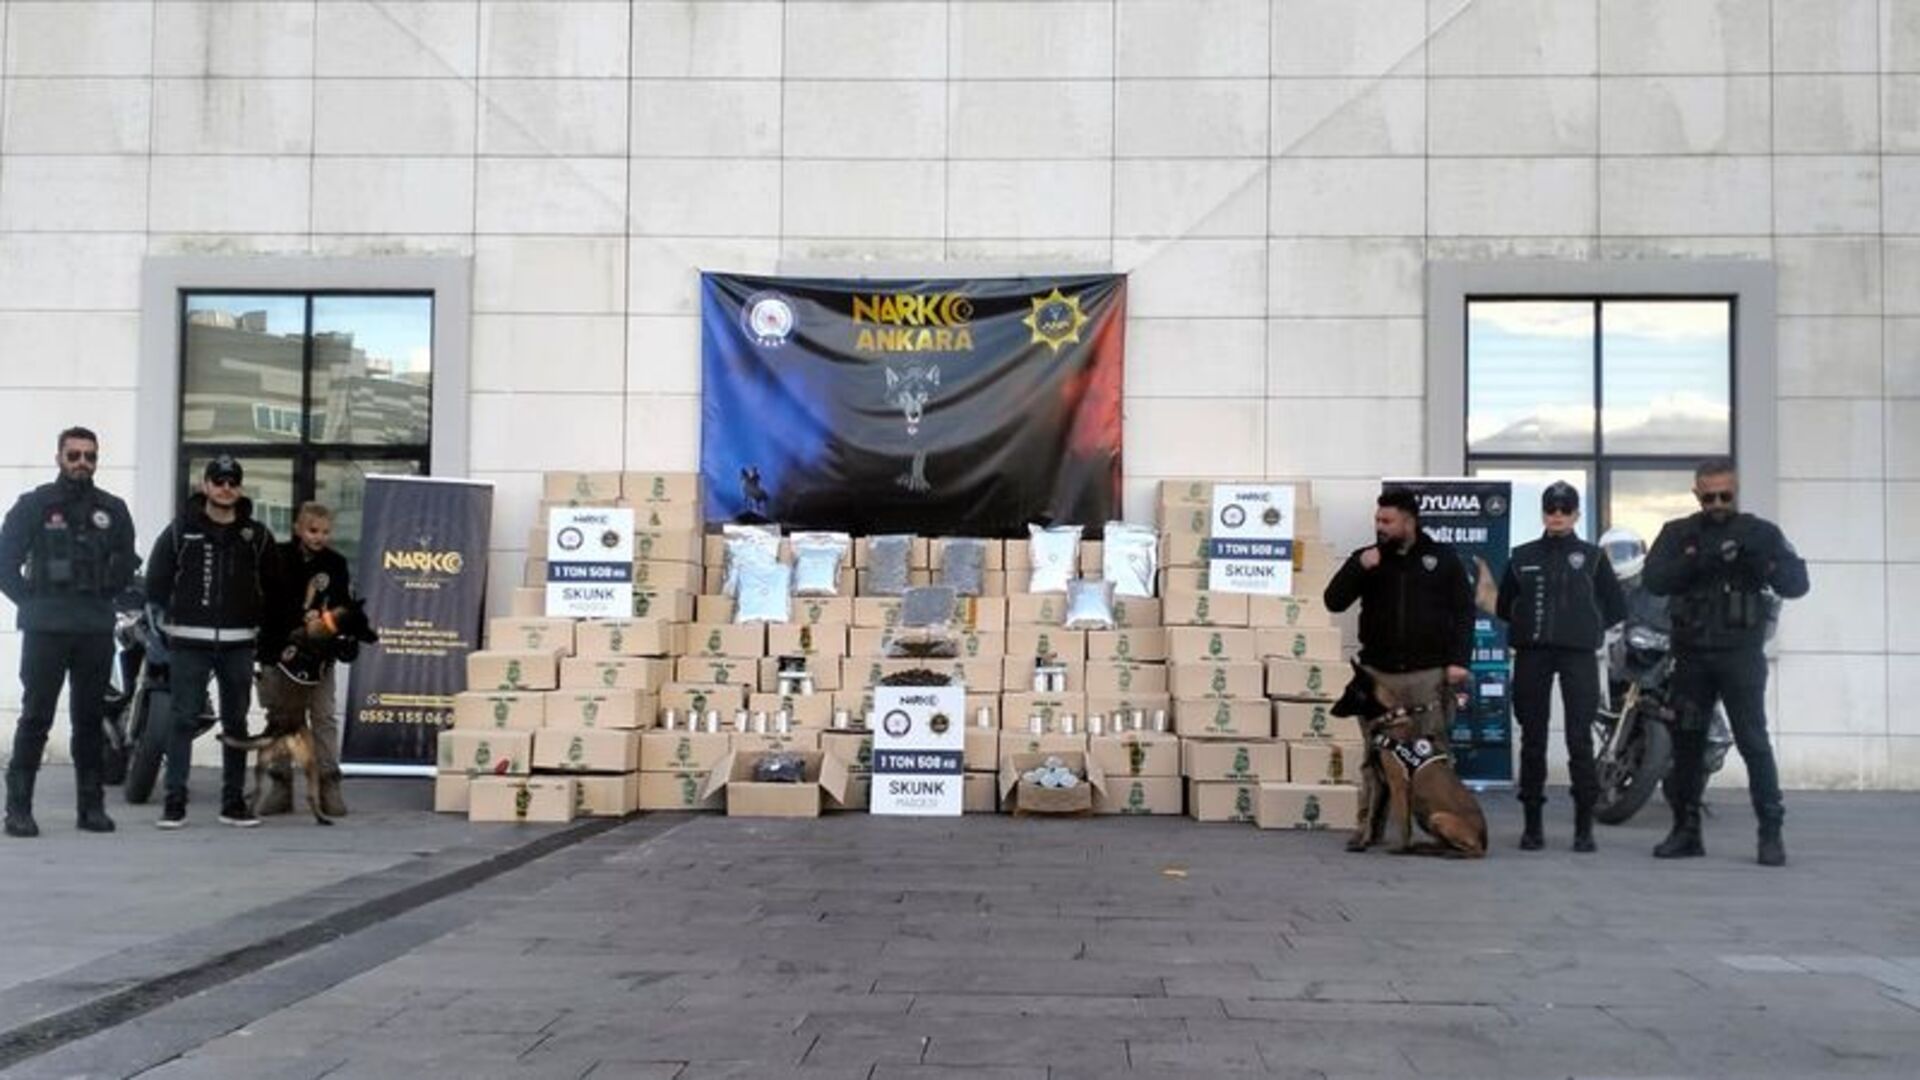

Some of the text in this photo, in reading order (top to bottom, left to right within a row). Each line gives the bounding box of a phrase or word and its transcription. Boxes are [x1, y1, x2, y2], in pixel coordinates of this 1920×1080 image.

[853, 292, 974, 327] NARKO
[855, 328, 974, 352] ANKARA
[1217, 543, 1223, 554] 1
[1225, 543, 1249, 555] TON
[1251, 544, 1272, 555] 508
[383, 551, 463, 574] NARKO
[554, 566, 560, 577] 1
[562, 566, 587, 577] TON
[589, 567, 611, 578] 508
[1225, 565, 1275, 577] SKUNK
[562, 588, 615, 600] SKUNK
[397, 711, 423, 724] 155
[881, 755, 886, 768] 1
[889, 755, 915, 769] TON
[917, 757, 941, 769] 508
[888, 781, 945, 795] SKUNK
